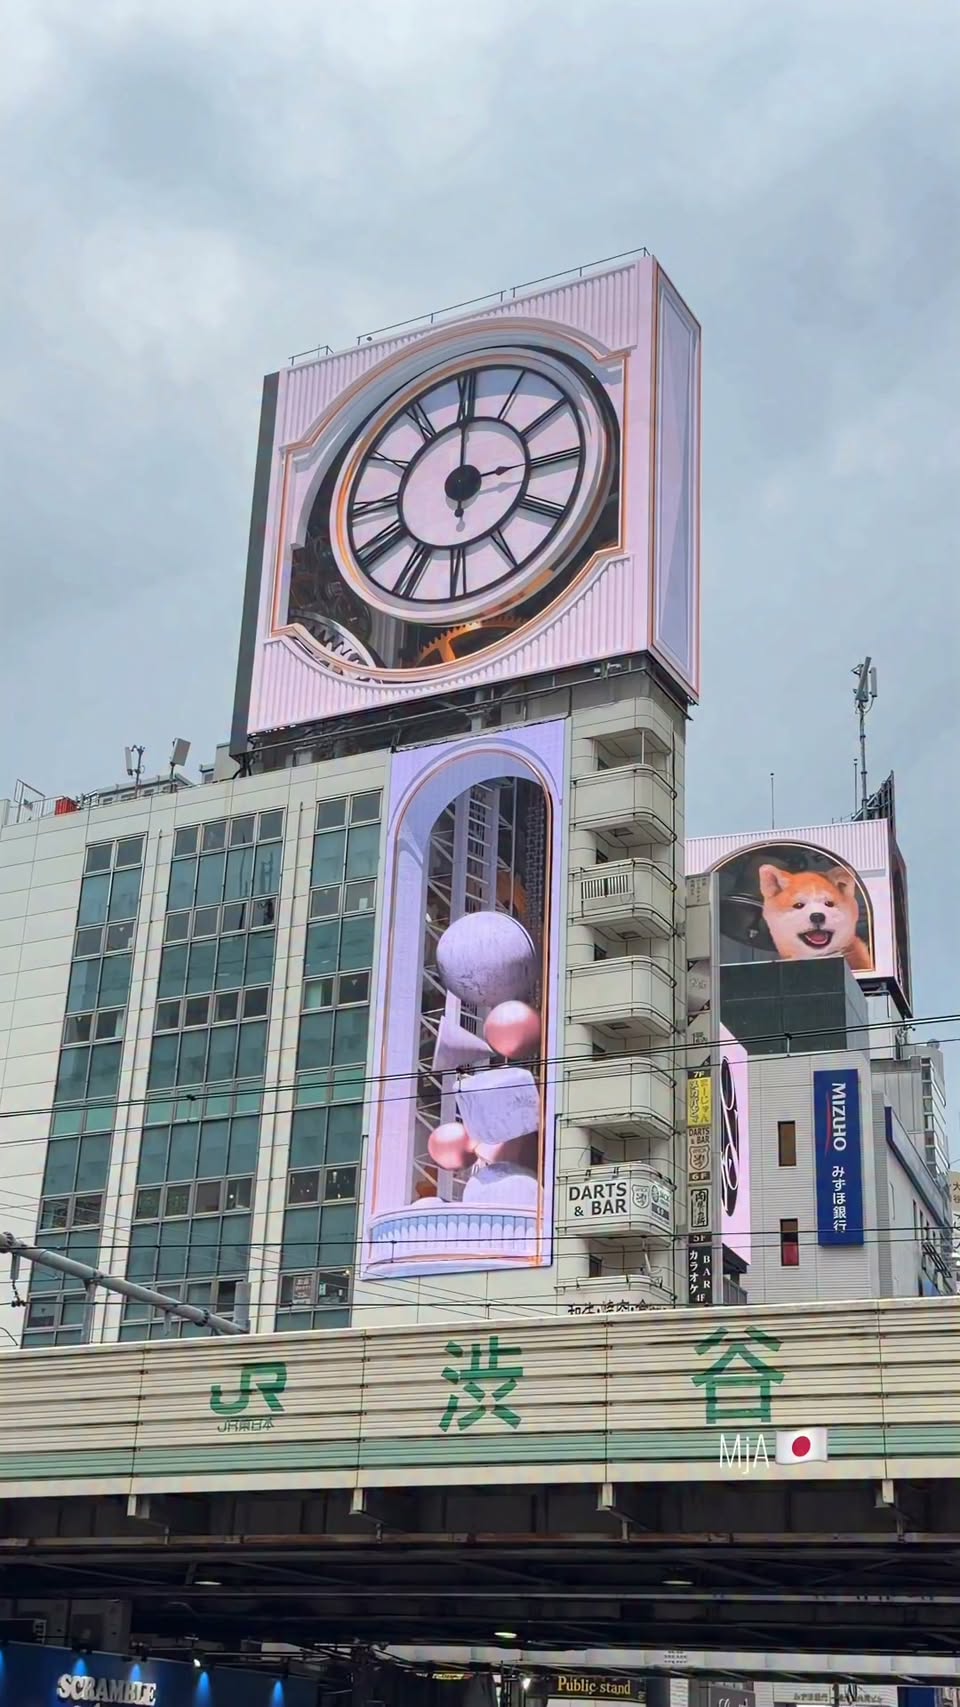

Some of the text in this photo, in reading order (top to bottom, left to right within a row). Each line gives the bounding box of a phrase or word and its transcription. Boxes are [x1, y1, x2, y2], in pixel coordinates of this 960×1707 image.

[689, 1127, 710, 1137] DARTS
[832, 1083, 847, 1151] MIZUHO
[697, 1135, 710, 1144] BAR
[569, 1182, 627, 1201] DARTS
[574, 1199, 627, 1216] & BAR
[832, 1166, 847, 1233] みずほ銀行
[690, 1250, 699, 1294] カラオケ
[703, 1255, 711, 1289] BAR
[210, 1362, 287, 1415] JR
[57, 1674, 157, 1706] SCRAMBLE
[557, 1676, 631, 1694] Public stand
